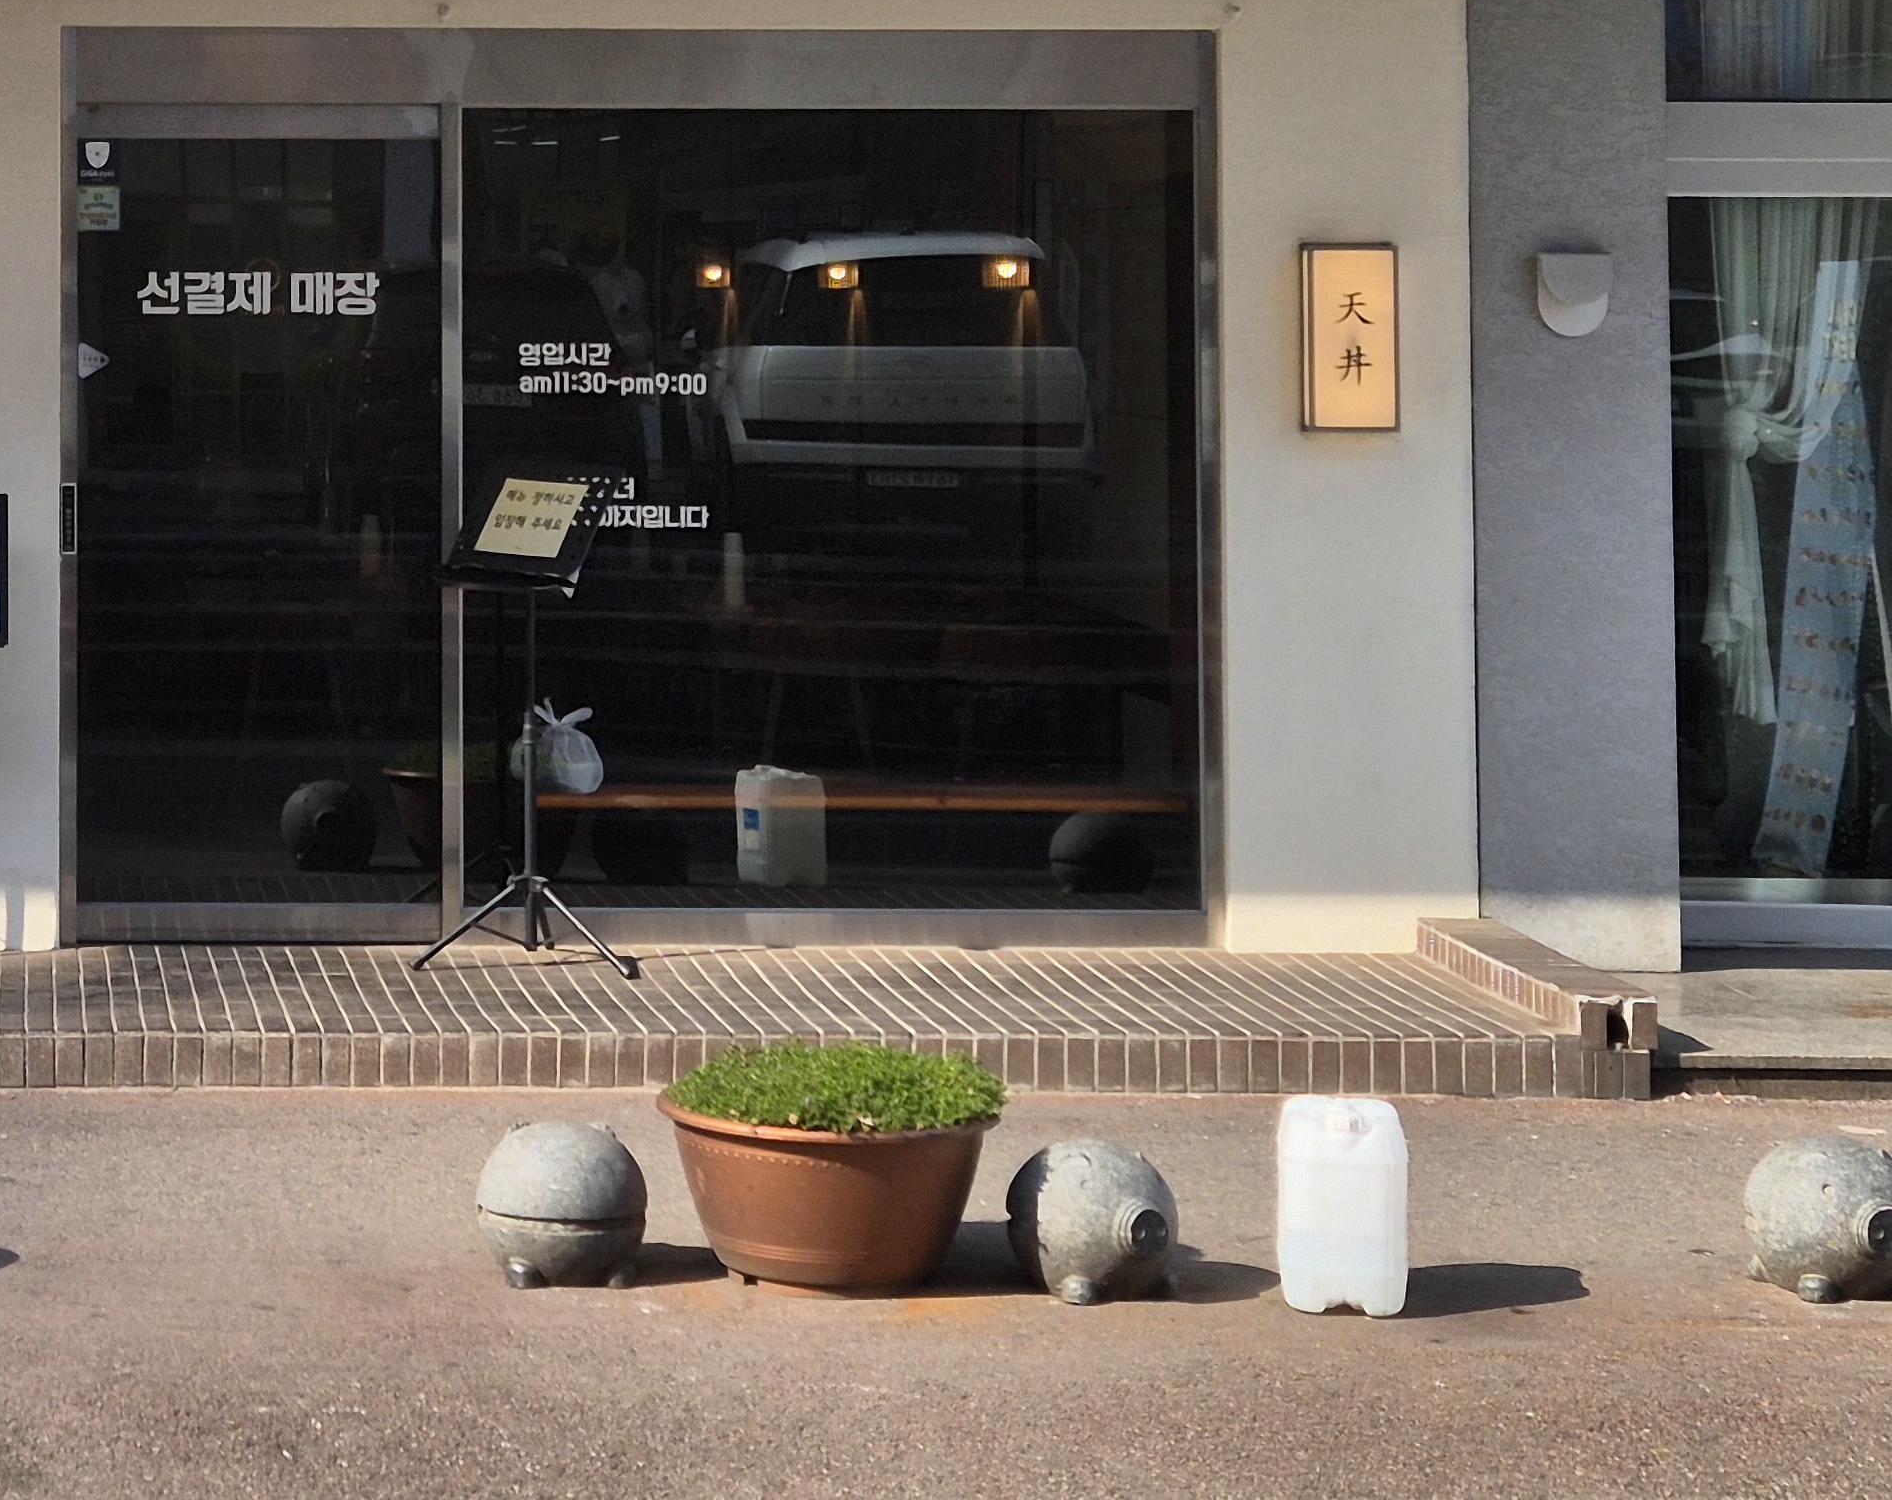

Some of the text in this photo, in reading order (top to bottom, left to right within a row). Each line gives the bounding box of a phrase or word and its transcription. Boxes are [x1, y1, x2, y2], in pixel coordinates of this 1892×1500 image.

[136, 271, 380, 316] 선결제 매장
[518, 342, 611, 367] 영업시간
[518, 371, 708, 396] am11:30~pm9:00
